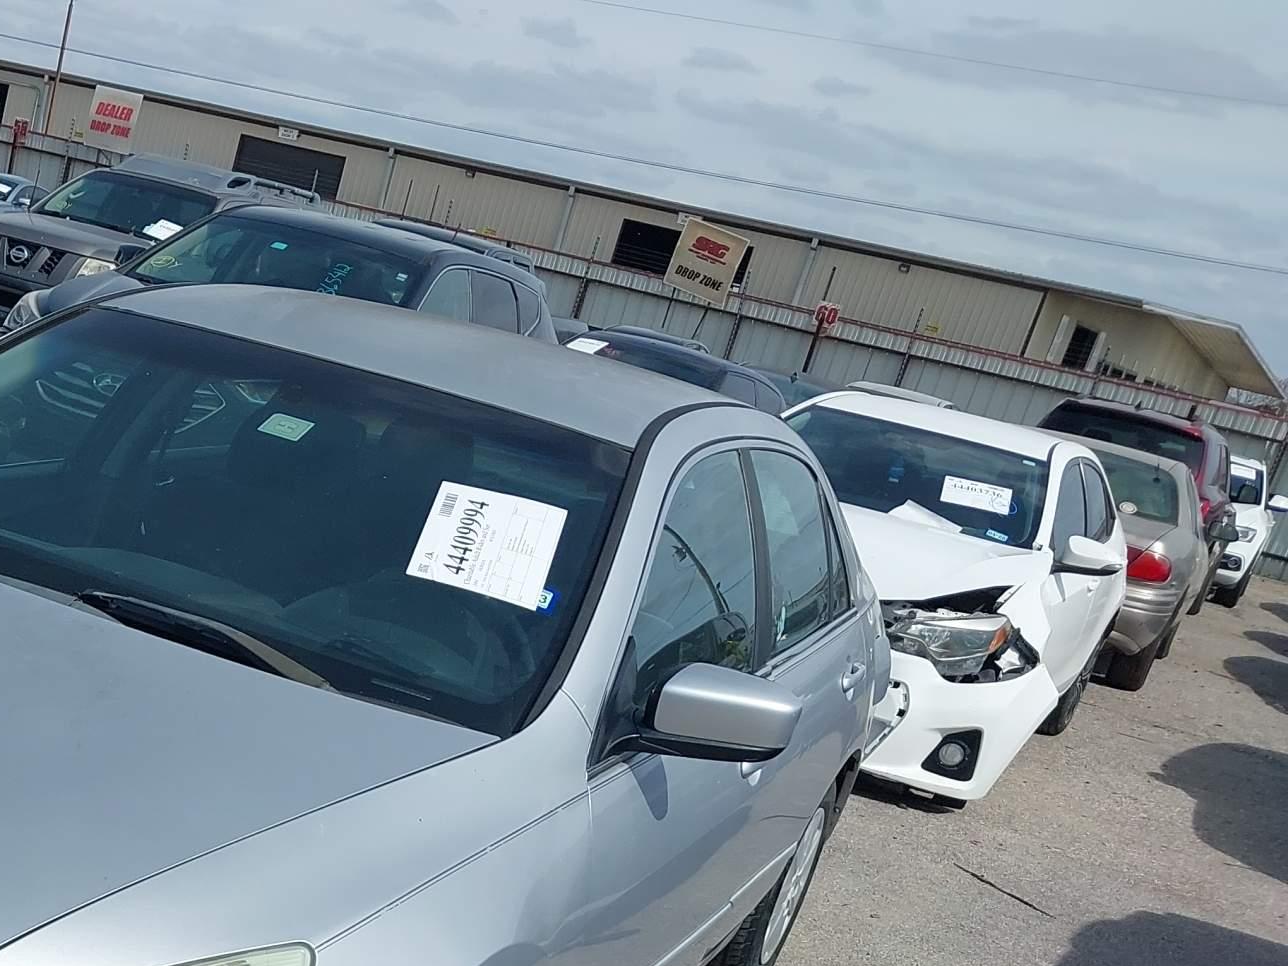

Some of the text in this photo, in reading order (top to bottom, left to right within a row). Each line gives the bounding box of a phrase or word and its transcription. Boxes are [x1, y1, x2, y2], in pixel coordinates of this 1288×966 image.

[95, 101, 133, 121] DEALER
[89, 119, 112, 134] DROP
[110, 124, 131, 138] ZONE
[675, 265, 724, 291] DROP ZONE
[815, 305, 839, 325] 60
[443, 499, 490, 576] 44409994
